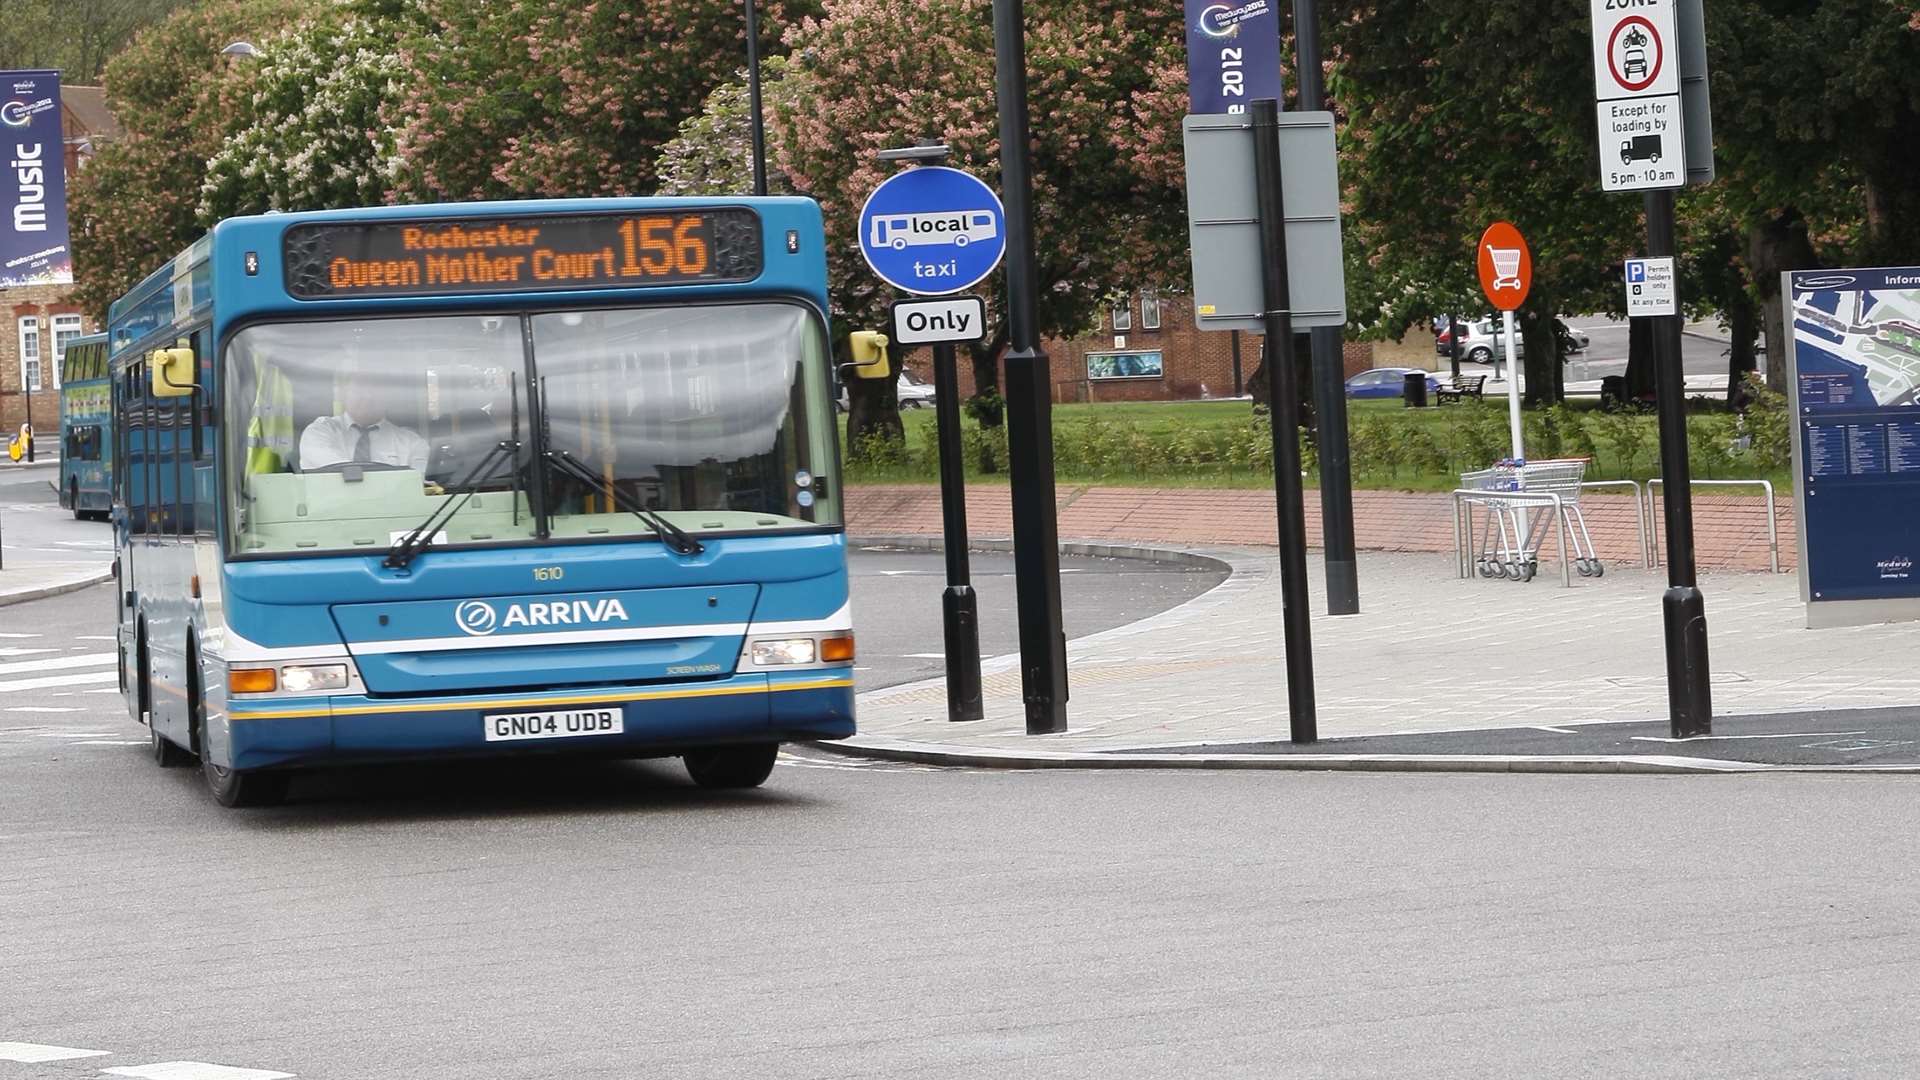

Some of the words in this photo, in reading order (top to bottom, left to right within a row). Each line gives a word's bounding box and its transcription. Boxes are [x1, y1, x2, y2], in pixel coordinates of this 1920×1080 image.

[1606, 0, 1657, 10] ZO
[1221, 47, 1244, 97] 2012
[1611, 104, 1648, 117] Except
[1651, 103, 1667, 115] for
[1612, 119, 1651, 132] loading
[1654, 118, 1667, 131] by
[912, 214, 969, 234] local
[402, 224, 541, 250] Rochester
[618, 217, 707, 277] 156
[329, 257, 420, 289] Queen
[425, 252, 526, 285] Mother
[531, 246, 616, 280] Court
[913, 259, 957, 278] taxi
[1631, 264, 1643, 281] P
[1648, 265, 1669, 273] Permit
[906, 310, 970, 333] Only
[532, 566, 564, 581] 1610
[502, 598, 629, 628] ARRIVA
[495, 714, 557, 736] GN04
[565, 711, 613, 733] UDB
